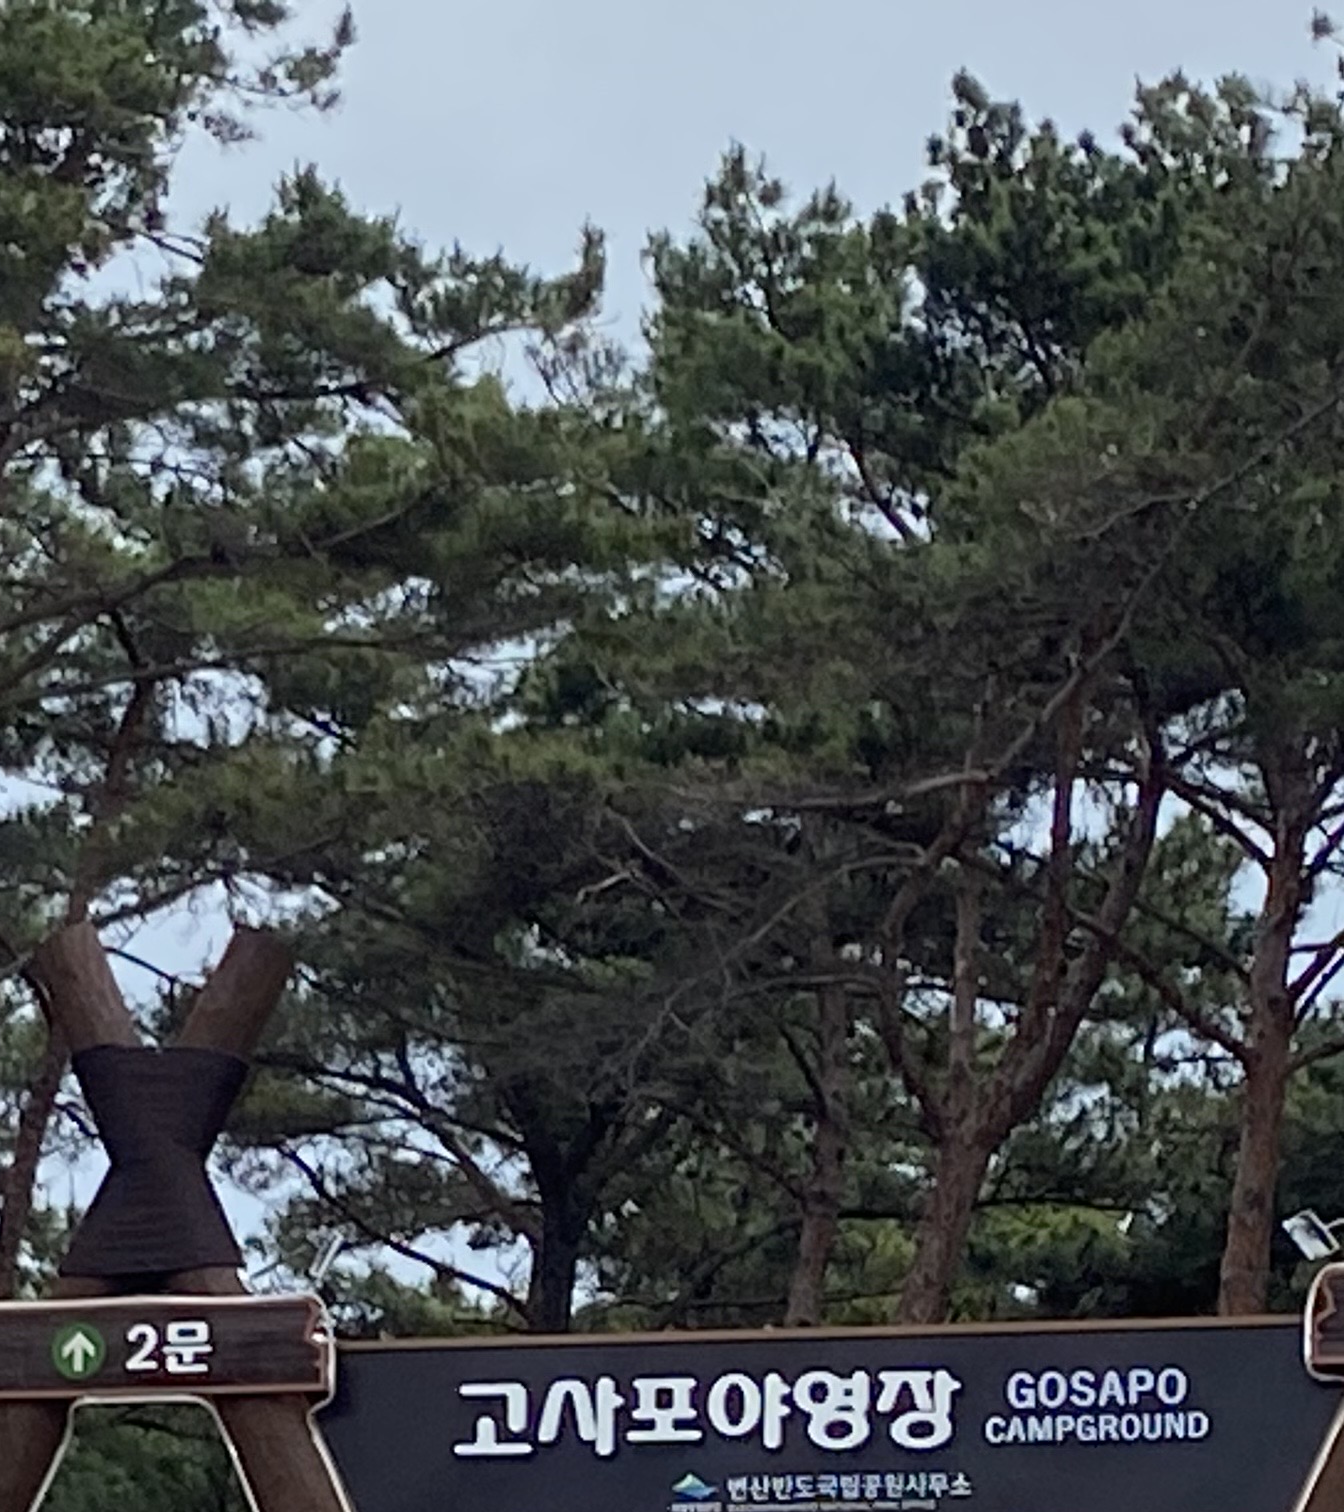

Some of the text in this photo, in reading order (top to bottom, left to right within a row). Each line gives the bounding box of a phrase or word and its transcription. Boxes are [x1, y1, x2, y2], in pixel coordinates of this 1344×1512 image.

[125, 1320, 213, 1374] 2문
[1006, 1367, 1188, 1409] GOSAPO
[453, 1369, 962, 1456] 고사포야영장
[984, 1410, 1210, 1444] CAMPGROUND
[726, 1472, 973, 1501] 변산반도국립공원사무소
